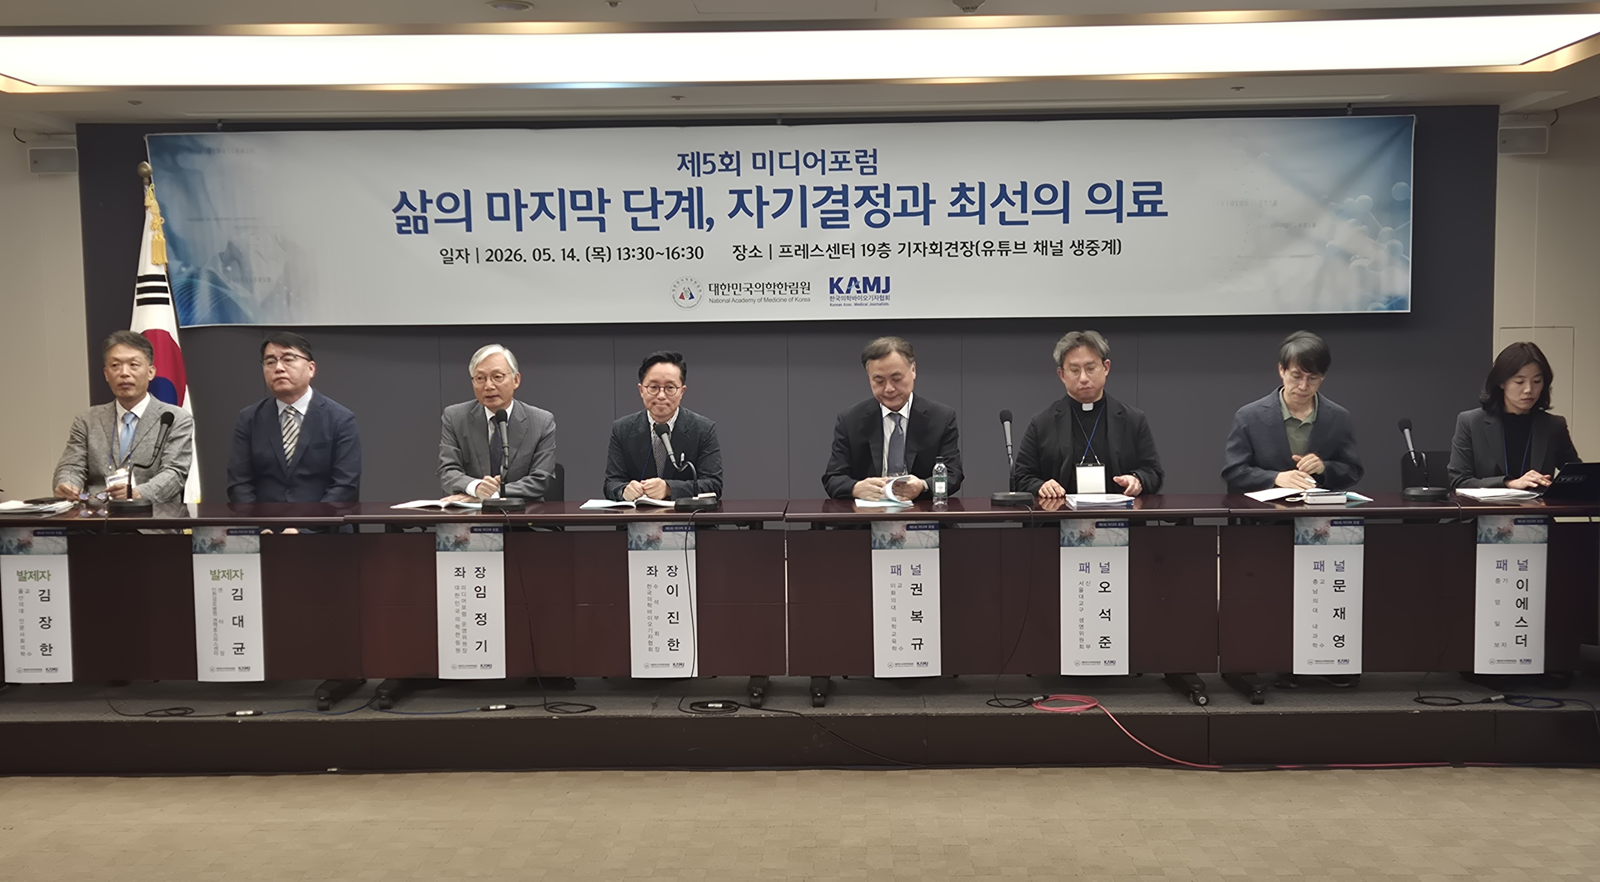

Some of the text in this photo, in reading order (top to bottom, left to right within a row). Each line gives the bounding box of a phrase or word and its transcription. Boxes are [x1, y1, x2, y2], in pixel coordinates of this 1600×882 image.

[677, 148, 878, 178] 제5회 미디어포럼
[392, 180, 1168, 235] 삶의 마지막 단계, 자기결정과 최선의 의료
[439, 248, 470, 265] 일자
[485, 248, 528, 263] 2026.
[532, 248, 556, 262] 05.
[560, 248, 580, 262] 14.
[586, 246, 612, 264] (목)
[617, 246, 704, 262] 13:30~16:30
[732, 244, 764, 262] 장소
[778, 242, 856, 260] 프레스센터
[861, 242, 892, 259] 19층
[898, 240, 1028, 258] 기자회견장(유튜브
[1033, 239, 1064, 257] 채널
[1069, 238, 1122, 256] 생중계)
[708, 281, 811, 296] 대한민국의학한림원
[829, 276, 890, 294] KAMJ
[16, 570, 51, 582] 발제자
[210, 568, 244, 581] 발제자
